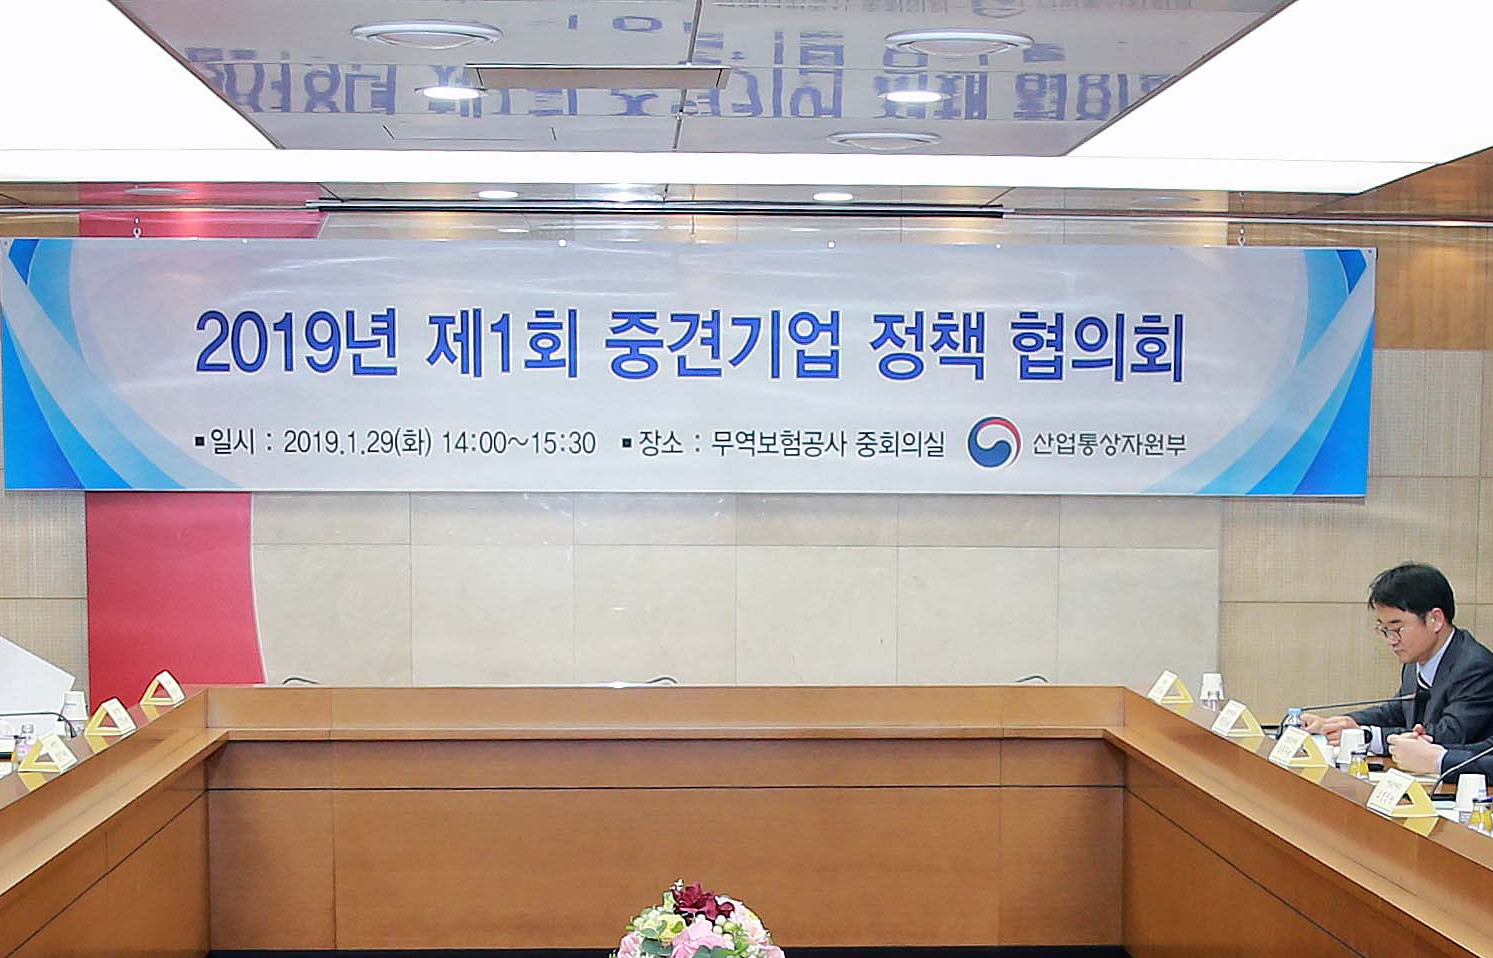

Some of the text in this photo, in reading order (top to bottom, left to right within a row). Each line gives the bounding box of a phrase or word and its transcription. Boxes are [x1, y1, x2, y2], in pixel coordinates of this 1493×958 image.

[194, 307, 1184, 383] 2019년 제1회 중견기업 정책 협의회
[210, 428, 254, 455] 일시
[284, 428, 432, 457] 2019.1.29(화)
[443, 431, 596, 454] 14:00~15:30
[639, 430, 683, 457] 장소
[712, 430, 848, 458] 무역보험공사
[855, 431, 944, 458] 중회의실
[1033, 432, 1187, 457] 산업통상자원부
